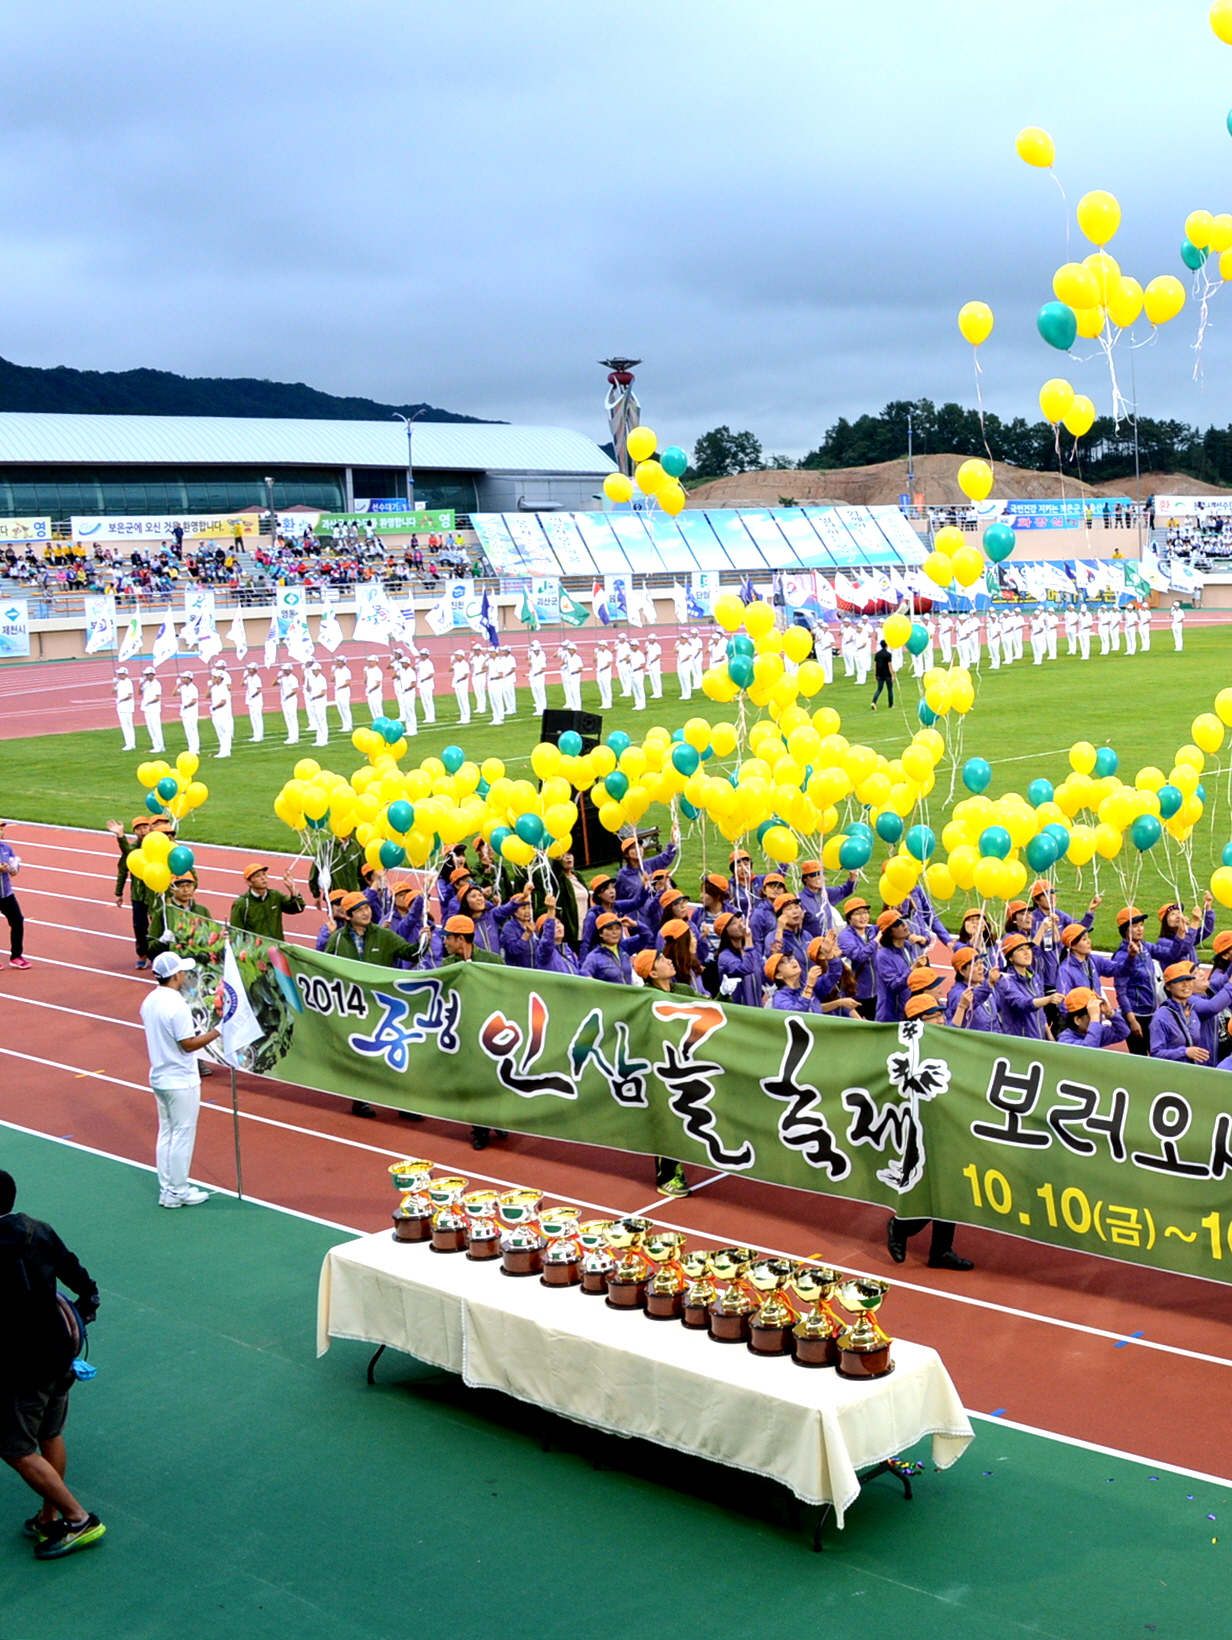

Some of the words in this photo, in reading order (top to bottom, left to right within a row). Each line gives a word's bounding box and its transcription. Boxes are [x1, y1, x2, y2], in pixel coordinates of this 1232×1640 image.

[1159, 499, 1171, 513] 환
[109, 521, 142, 534] 보은군에
[145, 520, 161, 533] 오신
[282, 517, 296, 533] 환
[379, 516, 417, 529] 환영합니다
[439, 513, 451, 528] 영
[33, 521, 46, 537] 영
[280, 609, 300, 619] 영동
[2, 624, 26, 635] 제천시
[296, 972, 367, 1020] 2014
[347, 977, 461, 1073] 증평
